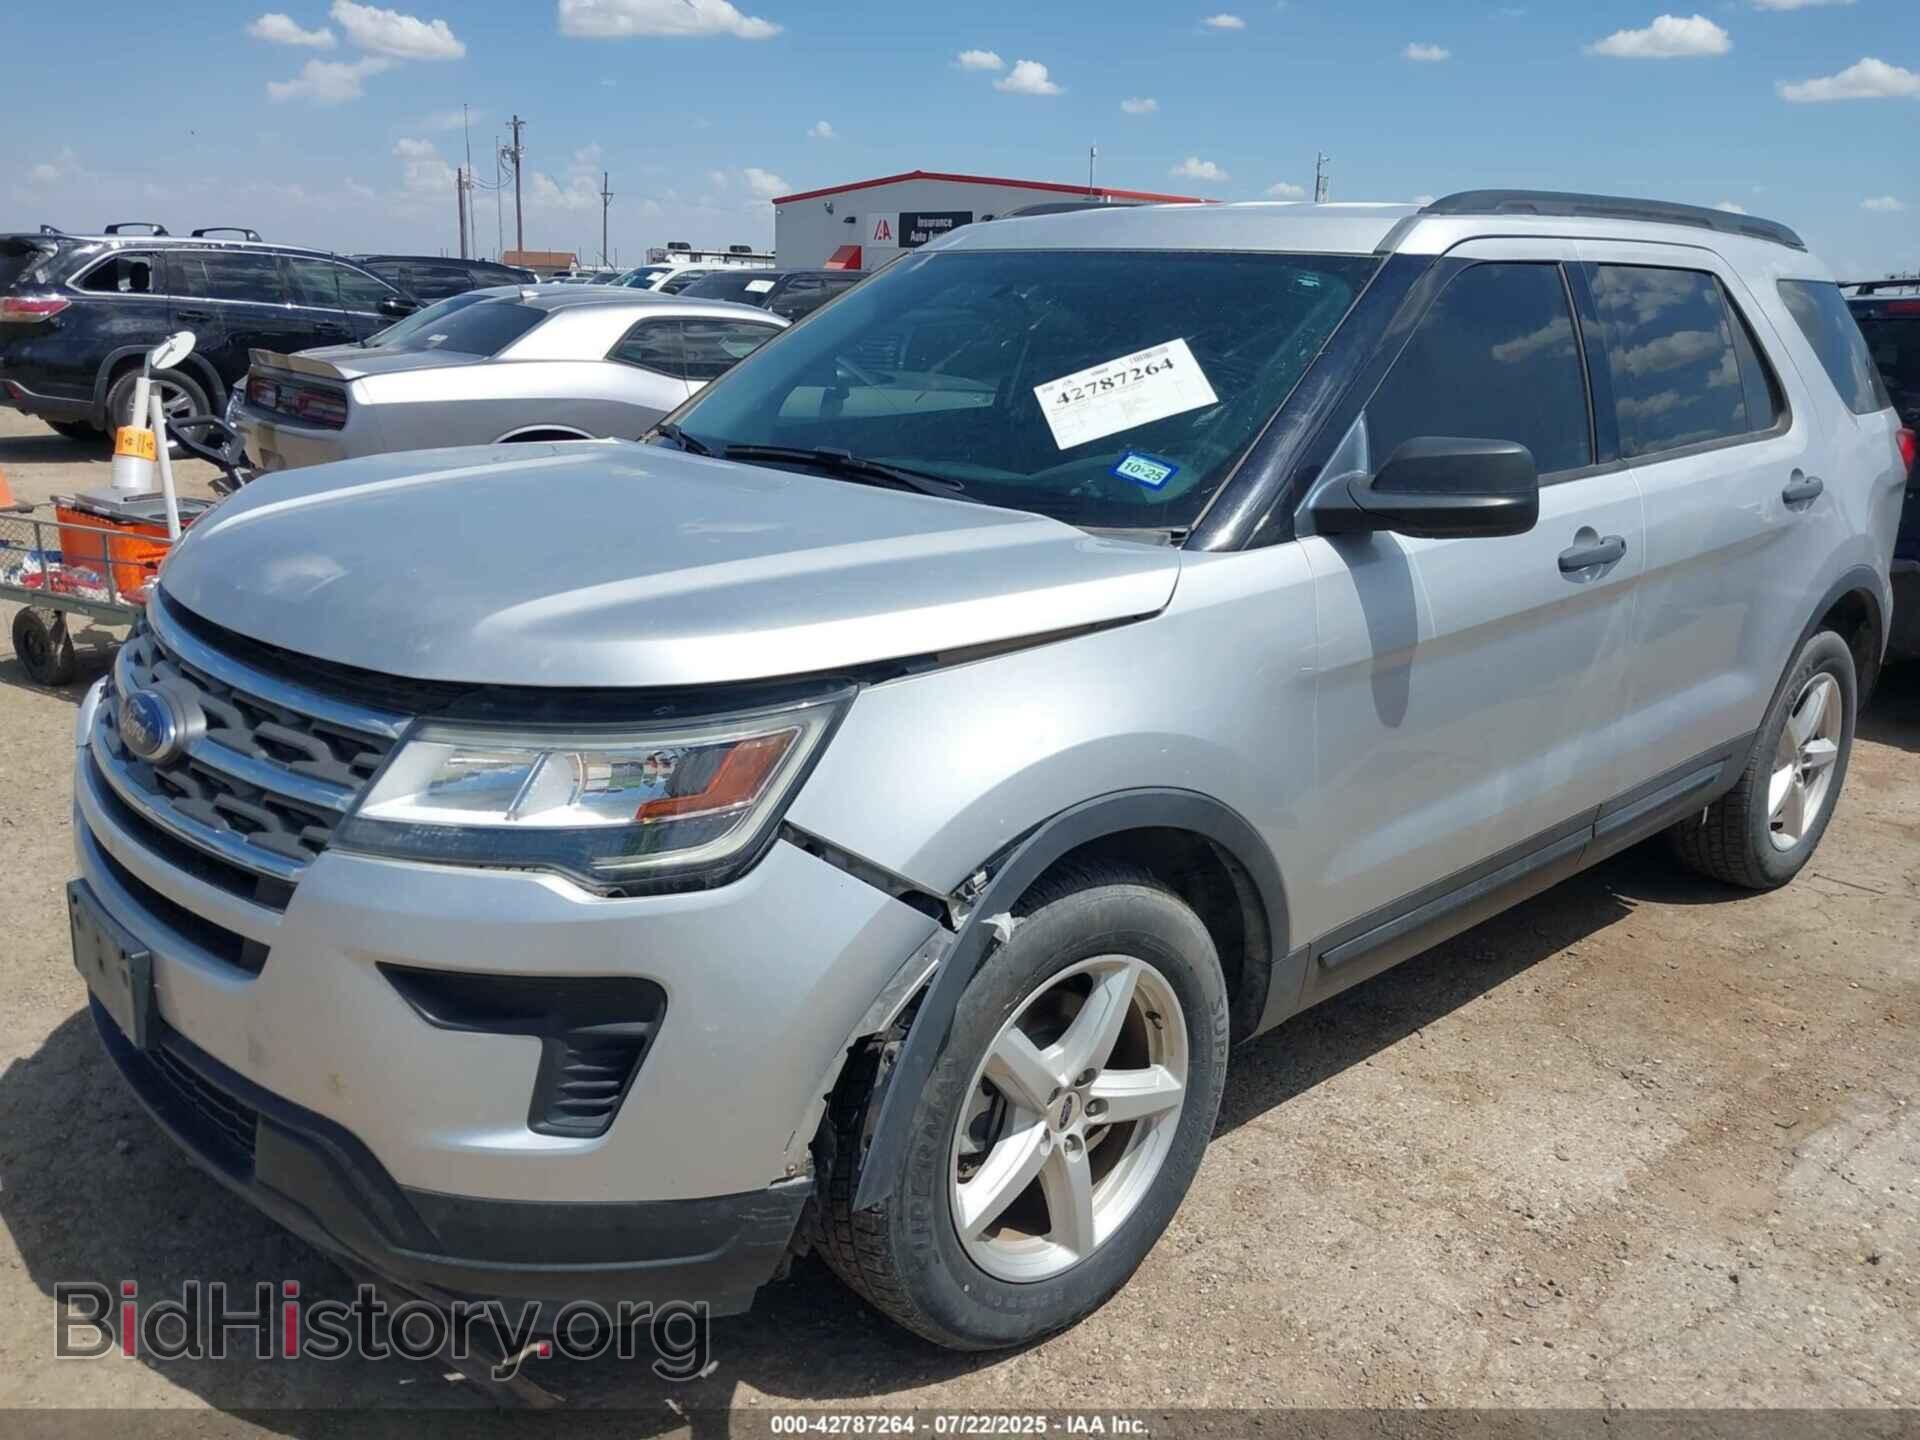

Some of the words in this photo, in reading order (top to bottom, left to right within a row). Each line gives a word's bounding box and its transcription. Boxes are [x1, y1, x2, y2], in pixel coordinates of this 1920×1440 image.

[917, 216, 953, 228] Insurance
[910, 230, 927, 242] Auto
[1056, 357, 1174, 405] 42787264
